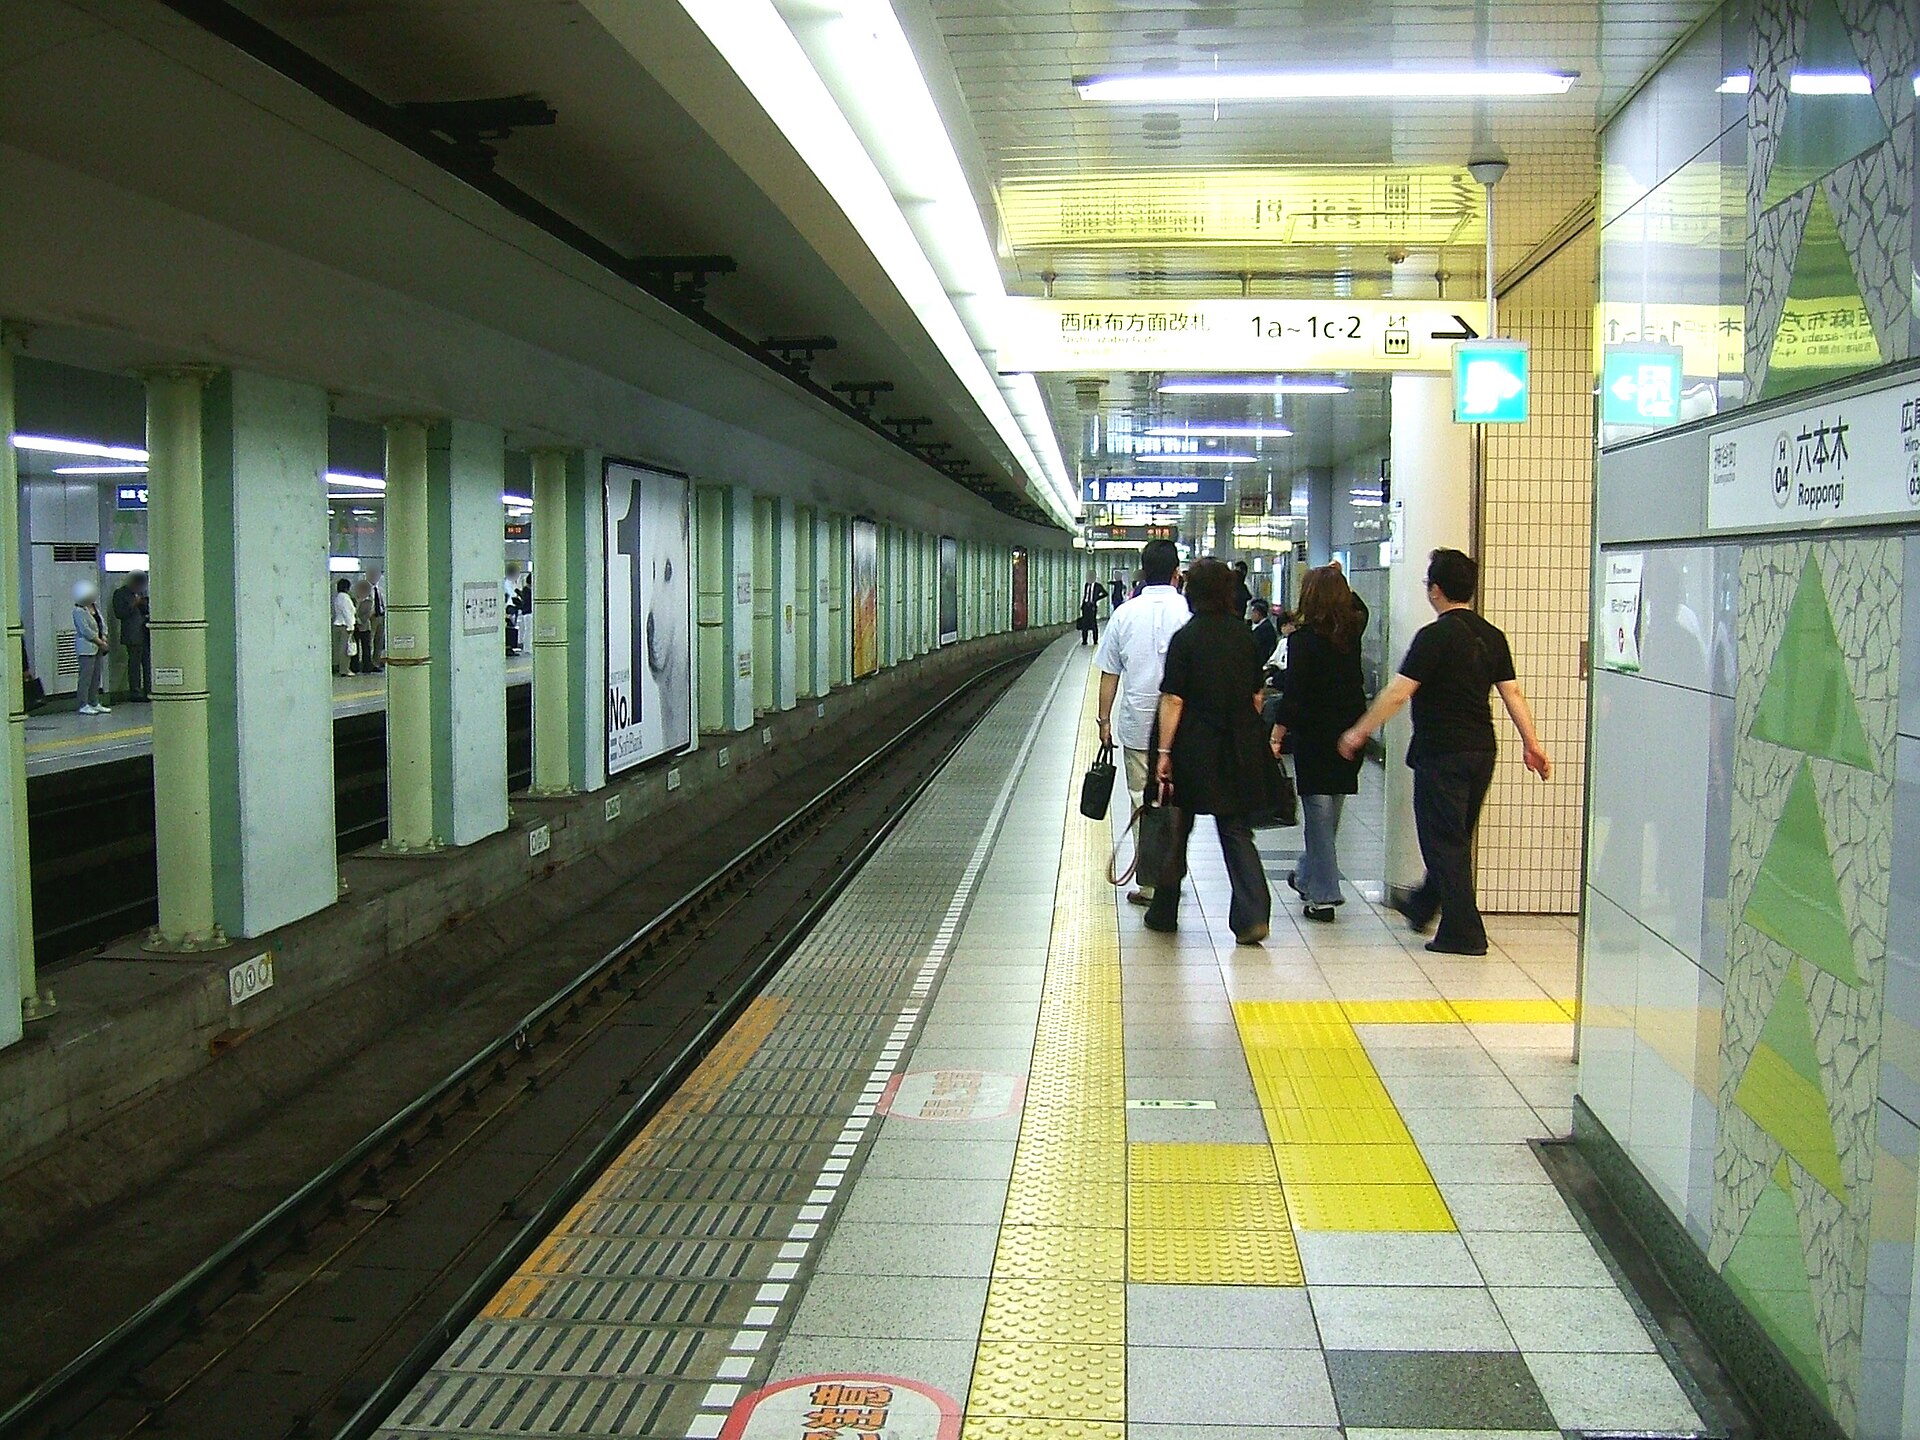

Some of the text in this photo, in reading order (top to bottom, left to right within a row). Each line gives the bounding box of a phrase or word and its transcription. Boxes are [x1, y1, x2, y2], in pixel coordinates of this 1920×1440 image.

[1061, 312, 1210, 332] 西麻布方面改札
[1779, 440, 1787, 461] H
[1796, 414, 1849, 474] 六本木
[1775, 466, 1788, 494] 04
[1797, 475, 1844, 511] Roppongi
[609, 686, 630, 733] No.
